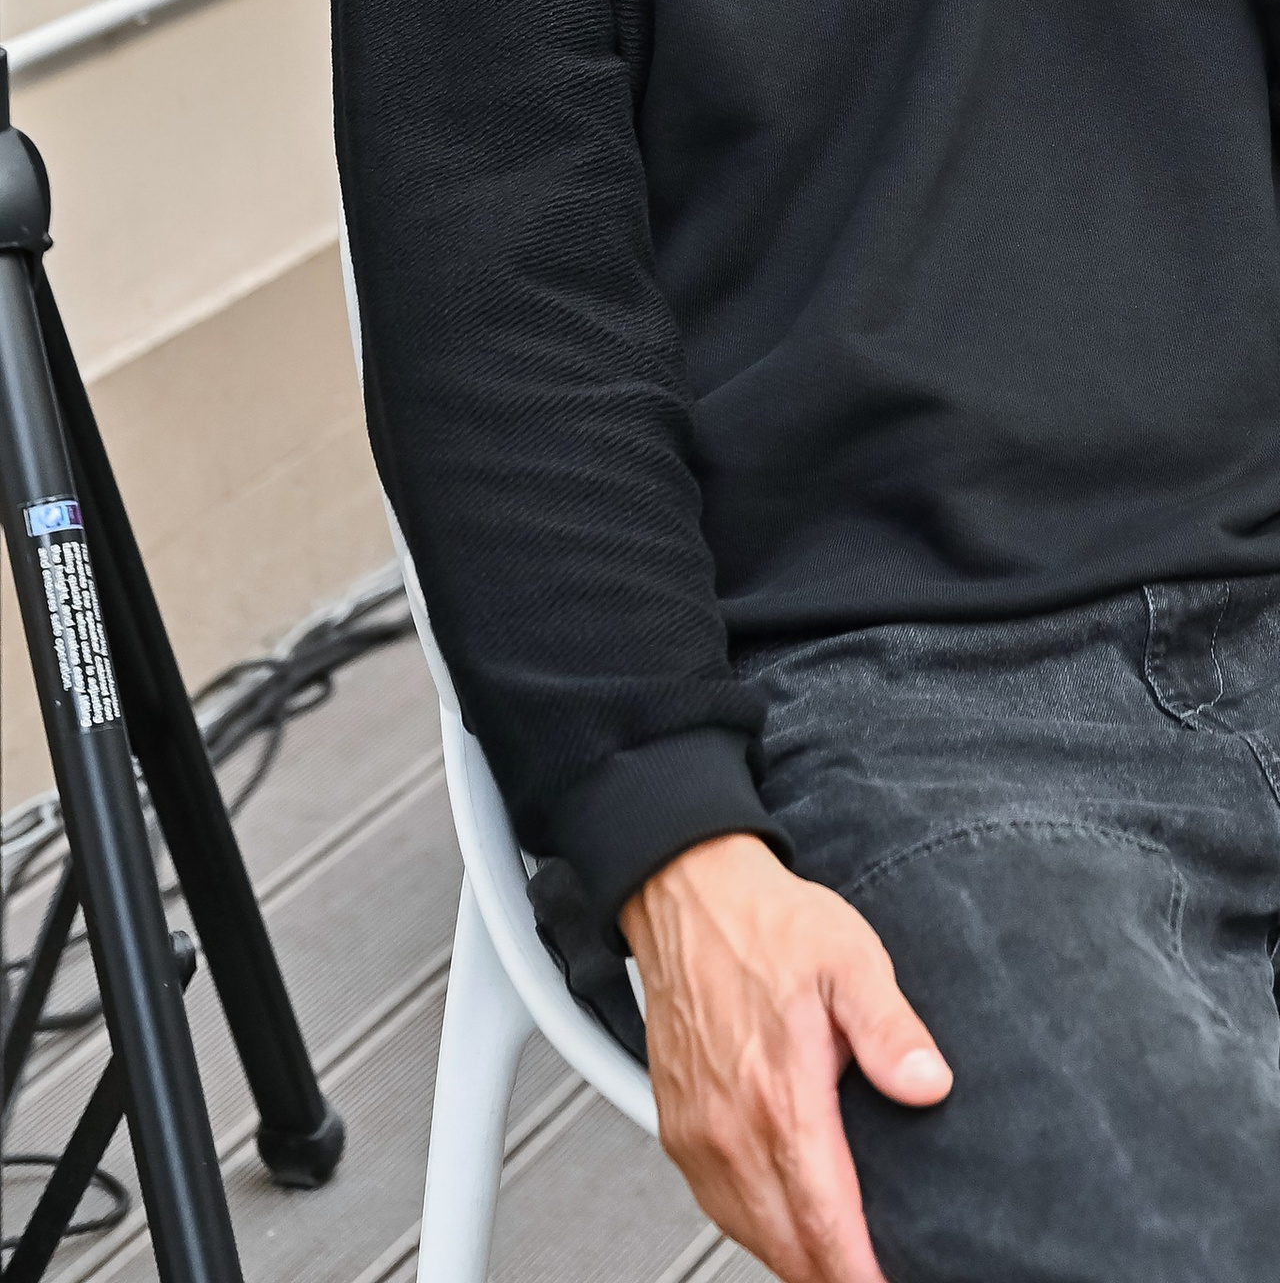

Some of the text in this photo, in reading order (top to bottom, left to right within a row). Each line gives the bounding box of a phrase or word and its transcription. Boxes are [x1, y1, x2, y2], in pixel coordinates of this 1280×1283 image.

[37, 547, 52, 569] and
[62, 542, 76, 574] falling
[42, 569, 58, 613] ensures
[67, 574, 83, 611] quickly
[50, 544, 62, 564] the
[61, 604, 76, 627] and
[72, 666, 87, 694] easy
[50, 613, 64, 638] safe
[75, 611, 88, 640] when
[87, 676, 105, 724] adjusting
